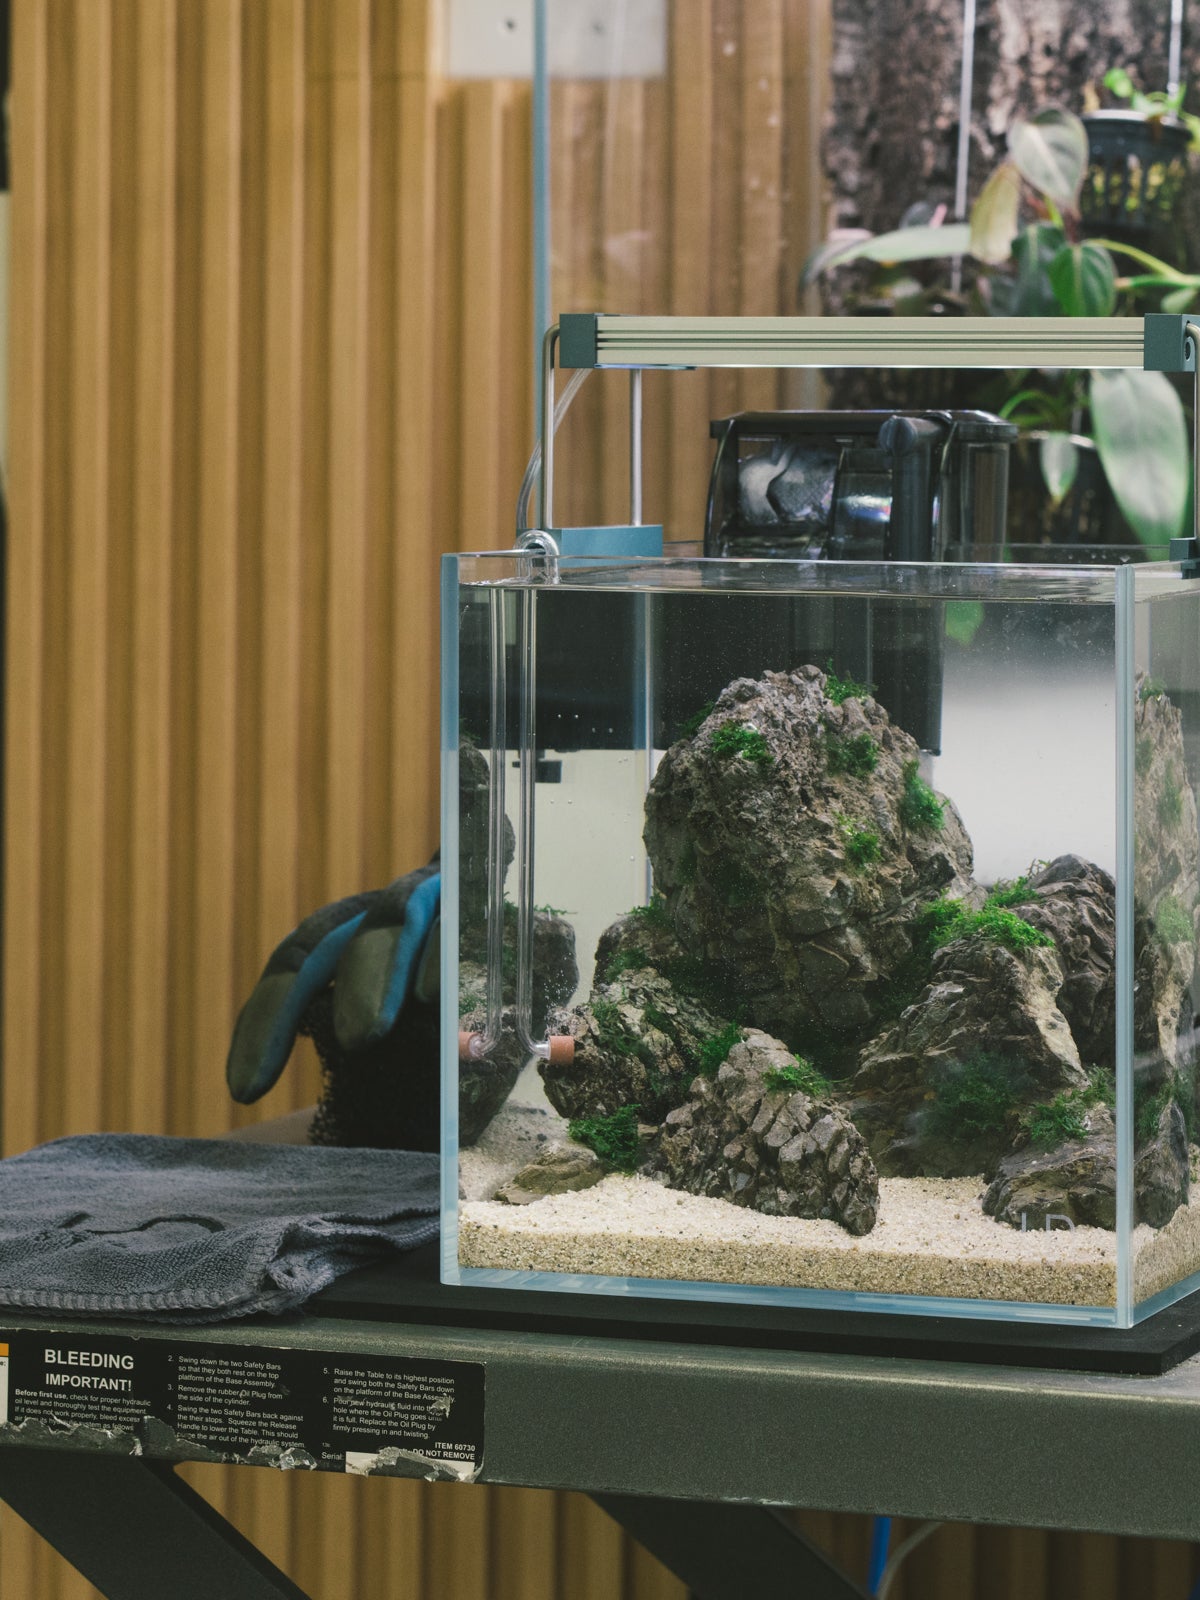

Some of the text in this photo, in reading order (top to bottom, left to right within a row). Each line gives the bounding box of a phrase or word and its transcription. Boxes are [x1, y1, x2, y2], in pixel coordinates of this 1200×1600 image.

[45, 1348, 134, 1370] BLEEDING
[178, 1355, 199, 1366] Swing
[199, 1357, 218, 1365] down
[230, 1360, 243, 1368] two
[243, 1361, 265, 1371] Safety
[266, 1363, 281, 1371] Bars
[178, 1373, 205, 1384] platform
[225, 1377, 242, 1385] Base
[201, 1366, 216, 1375] they
[268, 1372, 279, 1381] top
[334, 1368, 353, 1376] Raise
[367, 1371, 385, 1379] Table
[403, 1374, 428, 1384] highest
[428, 1376, 455, 1386] position
[46, 1373, 131, 1392] IMPORTANT!
[348, 1378, 367, 1387] swing
[397, 1383, 418, 1392] Safety
[15, 1388, 38, 1397] Before
[39, 1390, 53, 1398] first
[69, 1393, 89, 1401] check
[100, 1397, 121, 1406] proper
[178, 1384, 205, 1393] Remove
[218, 1388, 239, 1396] rubber
[251, 1391, 267, 1400] Plug
[355, 1388, 383, 1398] platform
[23, 1398, 39, 1406] level
[40, 1399, 52, 1407] and
[53, 1400, 87, 1412] thoroughly
[87, 1403, 100, 1411] test
[101, 1404, 112, 1412] the
[224, 1397, 250, 1407] cylinder.
[25, 1407, 42, 1415] does
[99, 1413, 118, 1421] bleed
[177, 1404, 198, 1414] Swing
[223, 1408, 245, 1418] Safety
[245, 1410, 261, 1418] Bars
[279, 1413, 303, 1423] against
[348, 1407, 370, 1415] where
[393, 1411, 409, 1420] Plug
[228, 1417, 257, 1428] Squeeze
[270, 1421, 297, 1429] Release
[359, 1417, 387, 1427] Replace
[411, 1422, 426, 1430] Plug
[177, 1422, 201, 1430] Handle
[209, 1425, 227, 1433] lower
[228, 1426, 239, 1434] the
[261, 1429, 275, 1437] This
[276, 1430, 298, 1439] should
[333, 1424, 351, 1433] firmly
[352, 1426, 381, 1436] pressing
[403, 1430, 429, 1440] twisting.
[435, 1442, 476, 1452] ITEM 60730
[443, 1451, 475, 1460] REMOVE
